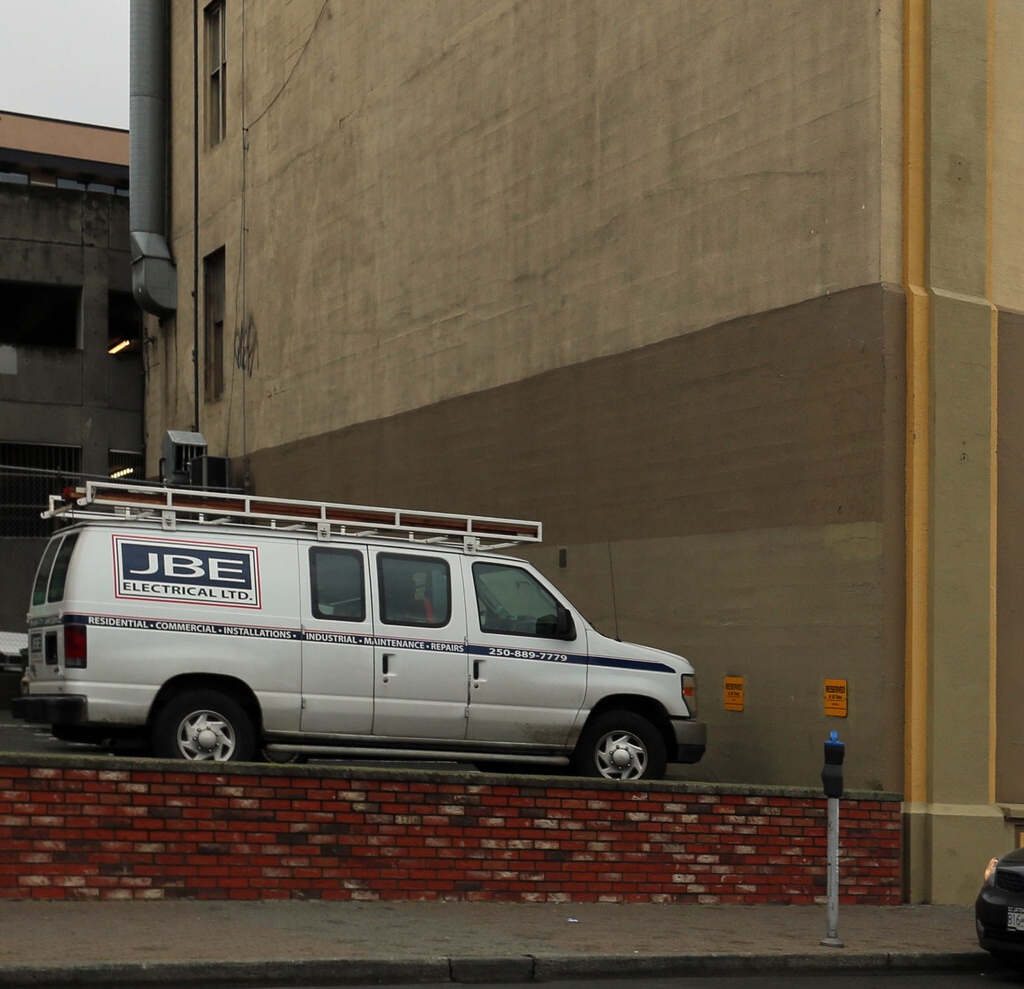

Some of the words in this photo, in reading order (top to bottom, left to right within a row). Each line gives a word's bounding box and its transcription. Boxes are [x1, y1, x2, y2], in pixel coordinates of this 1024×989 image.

[130, 552, 246, 583] JBE
[123, 582, 217, 598] ELECTRICAL
[221, 589, 253, 601] LTD.
[88, 616, 149, 629] RESIDENTIAL
[155, 621, 217, 634] COMMERCIAL
[223, 626, 292, 640] INSTALLATIONS
[306, 632, 358, 644] INDUSTRIAL
[364, 637, 425, 650] MAINTENANCE
[431, 642, 464, 653] REPAIRS
[488, 647, 568, 662] 250-889-7779
[825, 685, 845, 693] RESERVED
